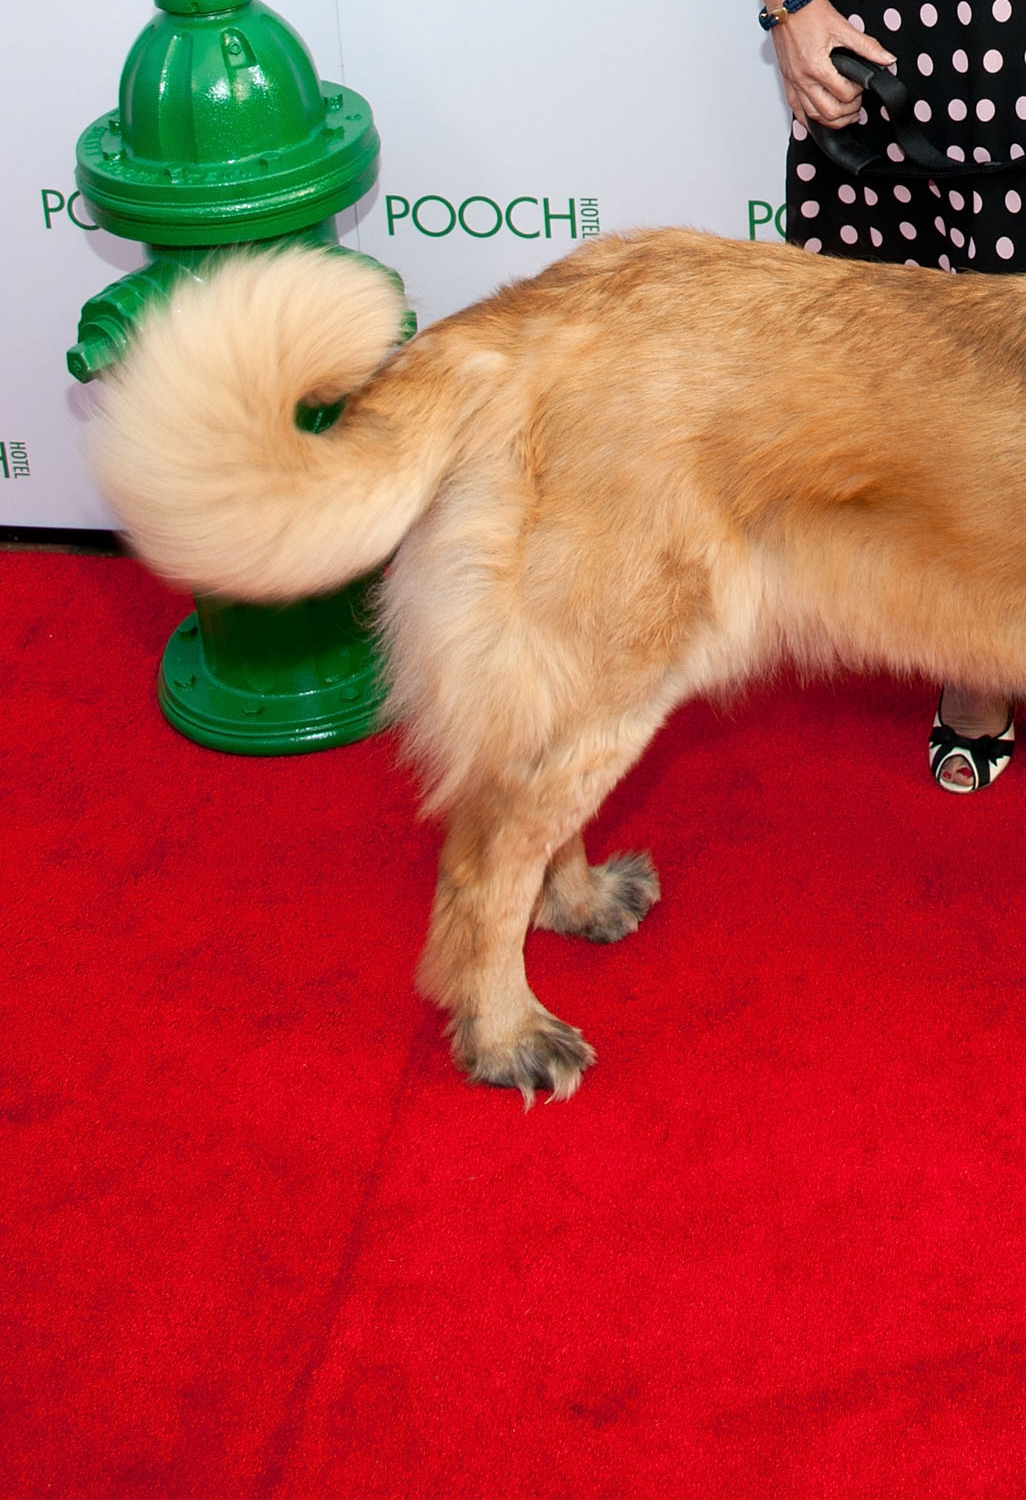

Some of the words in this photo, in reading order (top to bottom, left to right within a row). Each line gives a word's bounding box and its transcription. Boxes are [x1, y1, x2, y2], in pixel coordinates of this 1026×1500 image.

[386, 195, 576, 239] POOCH
[580, 198, 600, 239] HOTEL
[10, 441, 31, 479] HOTEL
